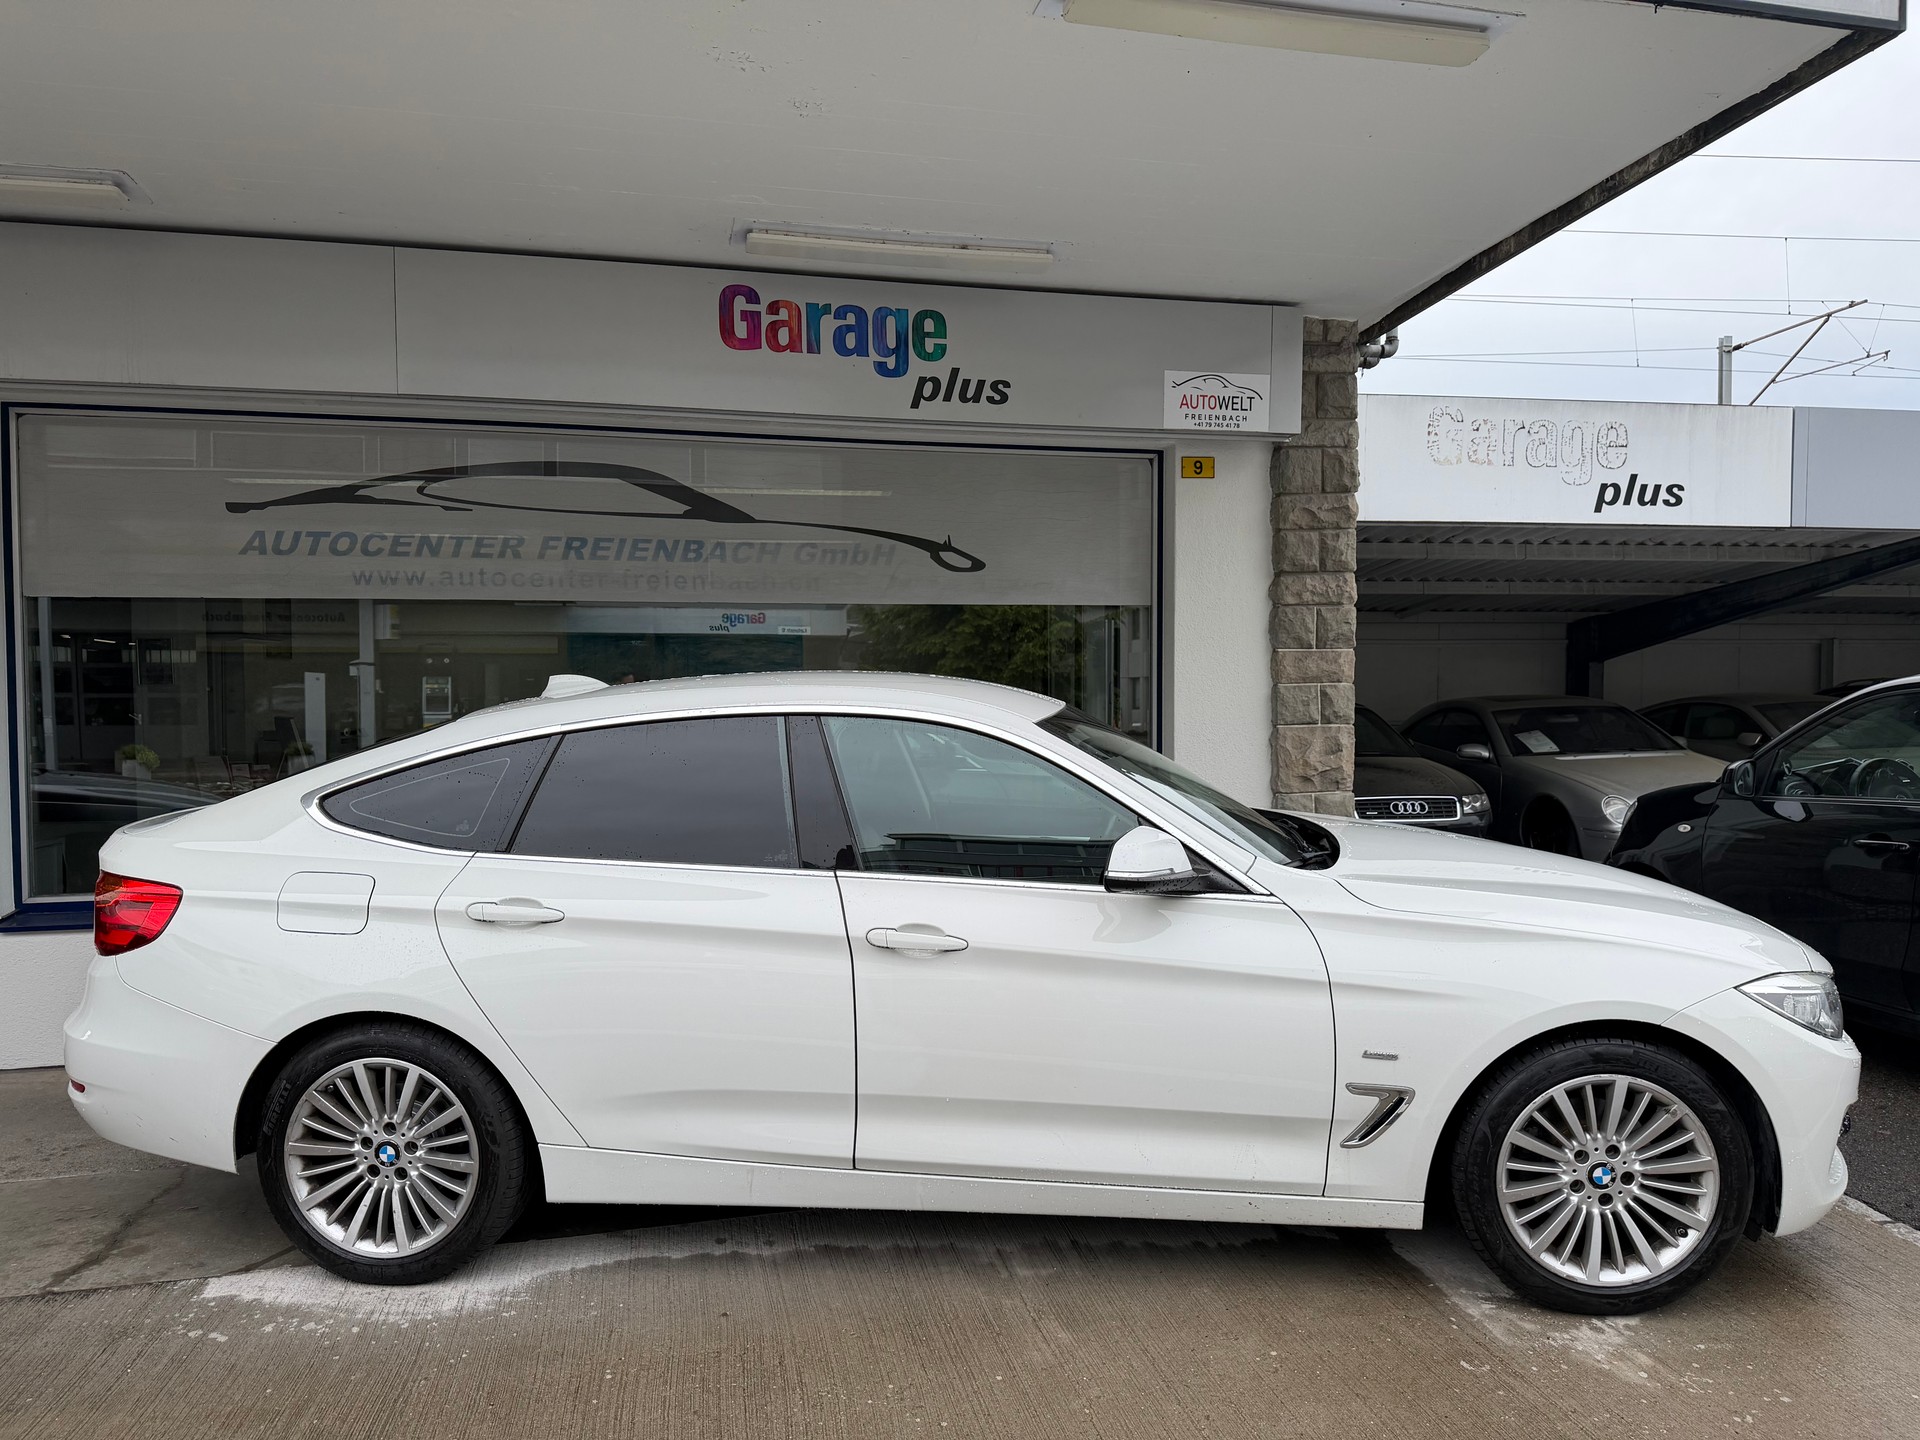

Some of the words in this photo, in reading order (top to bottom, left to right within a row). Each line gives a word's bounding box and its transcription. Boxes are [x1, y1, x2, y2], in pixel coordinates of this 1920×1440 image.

[718, 284, 948, 378] Garage
[910, 367, 1012, 410] plus
[1180, 394, 1255, 411] AUTOWELT
[1185, 413, 1247, 422] FREIENBACH
[1427, 405, 1629, 487] Garage
[1193, 460, 1203, 475] 9
[1593, 473, 1686, 514] plus
[238, 530, 525, 560] AUTOCENTER
[537, 535, 782, 564] FREIENBACH
[793, 542, 898, 567] GmbH
